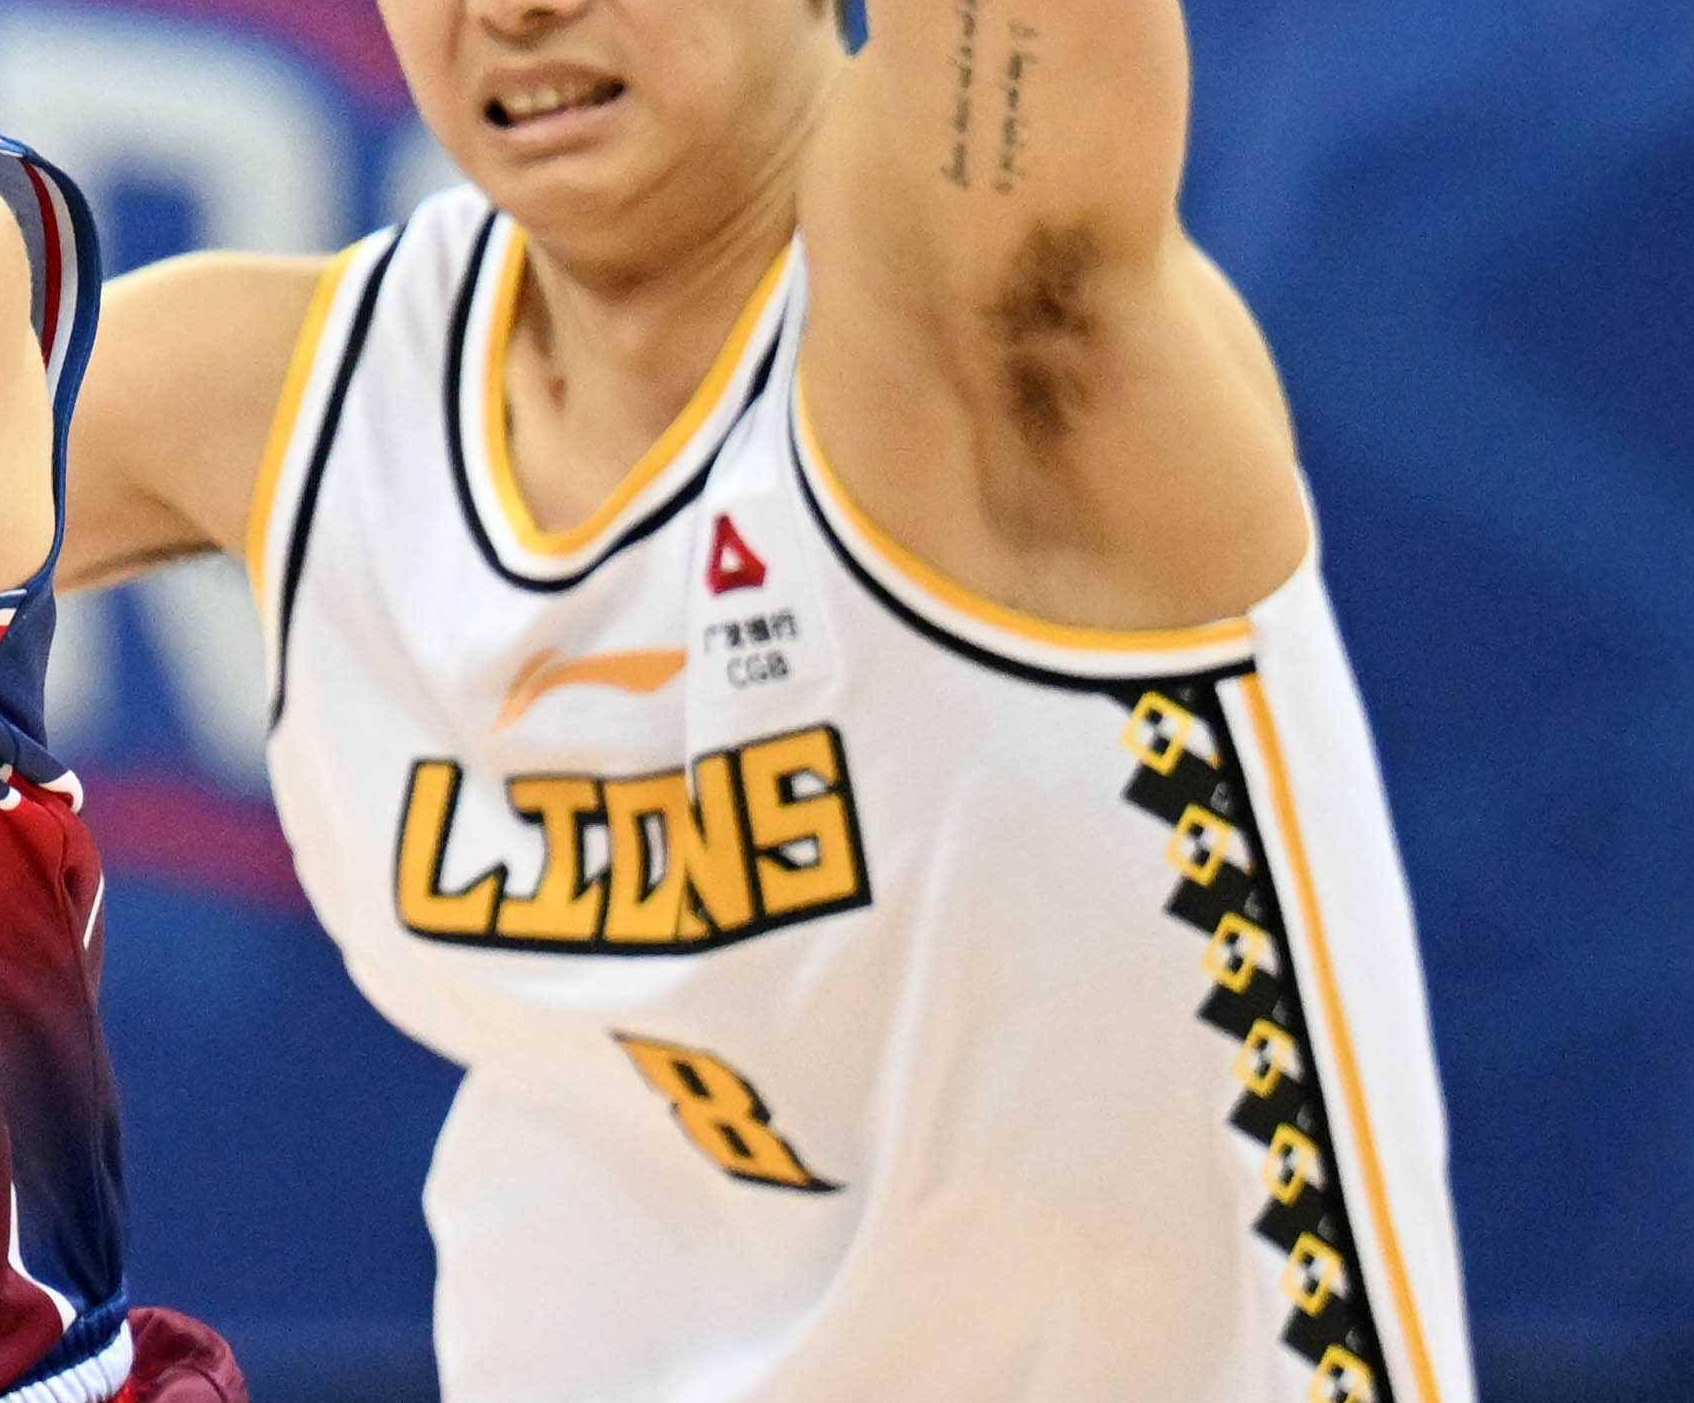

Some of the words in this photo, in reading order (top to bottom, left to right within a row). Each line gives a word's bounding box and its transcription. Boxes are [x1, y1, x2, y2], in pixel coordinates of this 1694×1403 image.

[727, 650, 790, 690] CGB
[394, 720, 873, 957] LIONS
[609, 1025, 846, 1195] 8
